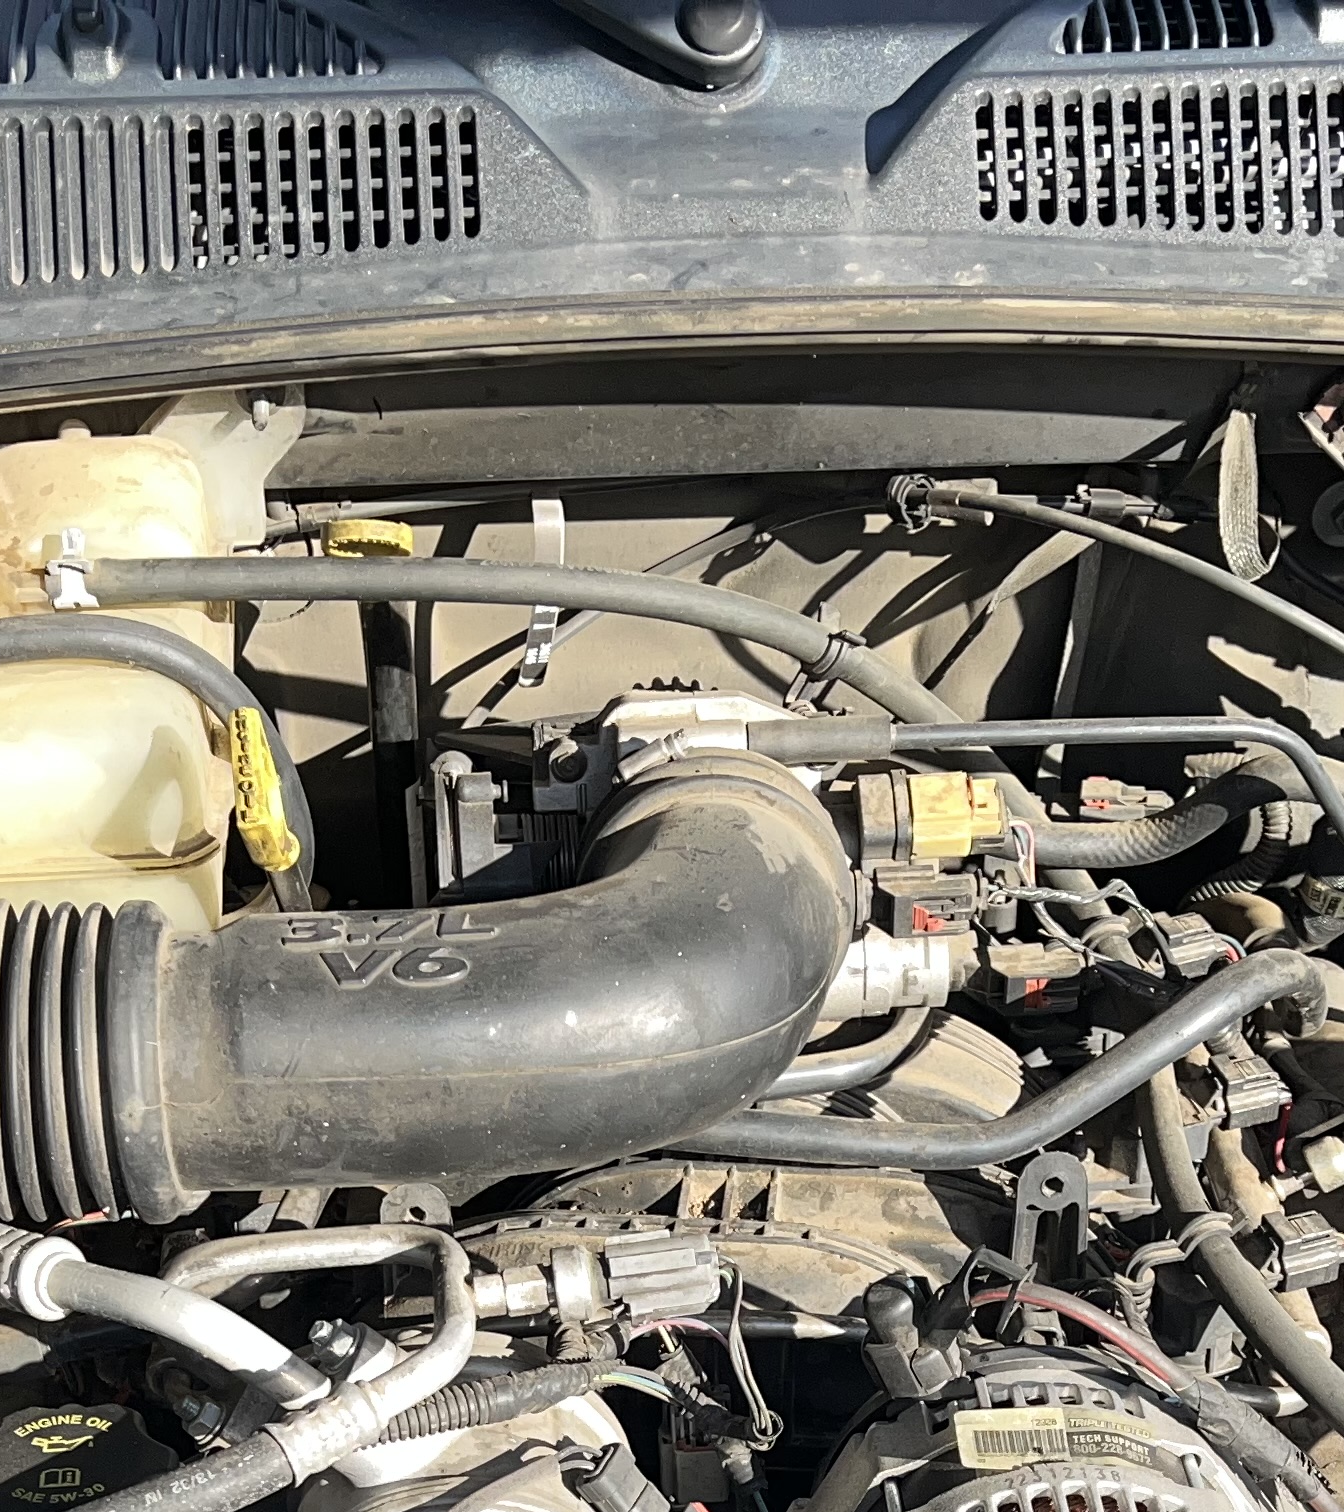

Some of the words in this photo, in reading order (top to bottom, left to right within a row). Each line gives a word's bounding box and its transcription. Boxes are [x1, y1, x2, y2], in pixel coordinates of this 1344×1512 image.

[280, 912, 501, 946] 3.7L
[319, 947, 470, 988] V6
[14, 1414, 83, 1438] ENGINE
[86, 1416, 115, 1432] OIL
[1073, 1434, 1101, 1444] TECH
[1105, 1433, 1150, 1454] SUPPORT
[11, 1487, 43, 1504] SAE
[49, 1483, 105, 1504] 5W-30
